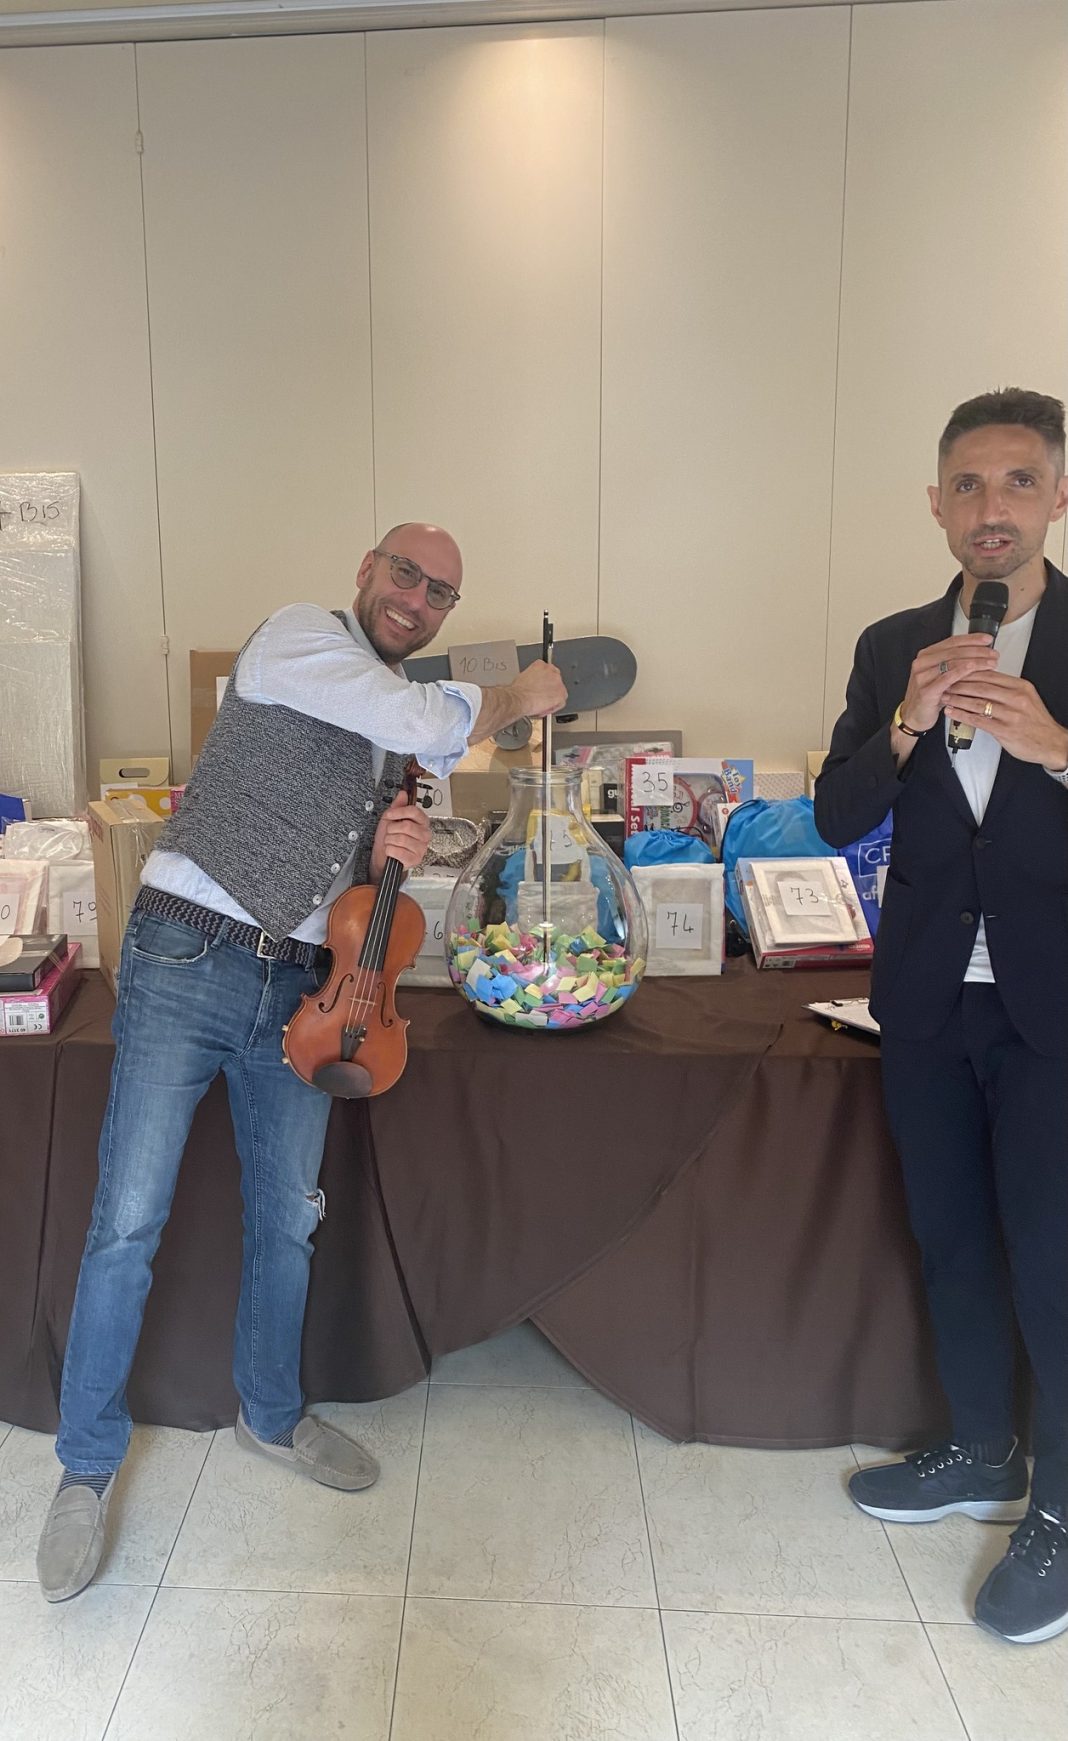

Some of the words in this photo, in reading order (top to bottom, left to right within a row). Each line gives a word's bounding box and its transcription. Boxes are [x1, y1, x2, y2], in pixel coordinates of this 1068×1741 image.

[459, 656, 478, 674] 10
[642, 772, 668, 793] 35
[724, 768, 737, 793] Band
[790, 886, 819, 905] 73
[666, 911, 694, 937] 74
